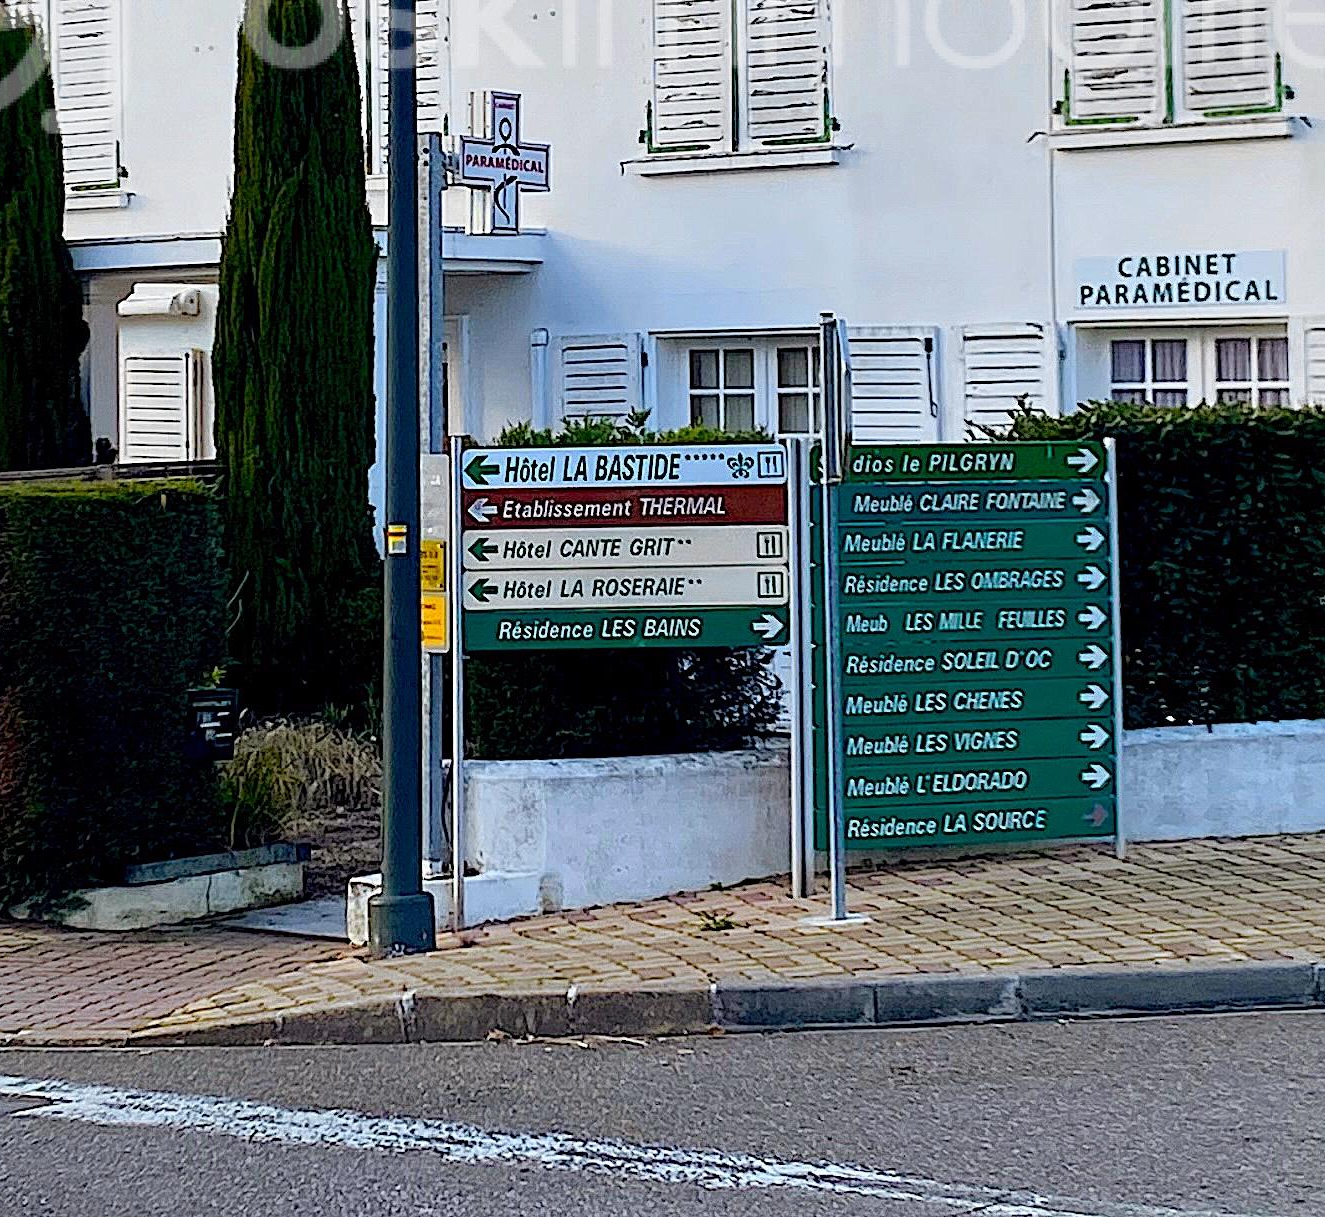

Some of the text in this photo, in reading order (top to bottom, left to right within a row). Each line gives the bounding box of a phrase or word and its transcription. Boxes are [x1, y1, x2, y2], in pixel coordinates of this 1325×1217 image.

[466, 154, 544, 174] PARAMÉDICAL
[1118, 253, 1237, 278] CABINET
[1080, 278, 1278, 305] PARAMÉDICAL
[504, 453, 681, 483] Hôtel LA BASTIDE
[902, 454, 921, 473] le
[928, 452, 1014, 473] PILGRYN
[502, 497, 726, 520] Etablissement THERMAL
[853, 491, 1066, 514] Meublé CLAIRE FONTAINE
[503, 537, 676, 560] Hôtel CANTE GRIT
[844, 531, 1024, 553] Meublé LA FLANERIE
[503, 577, 686, 599] Hôtel LA ROSERAIE
[844, 570, 1064, 594] Résidence LES OMBRAGES
[498, 617, 701, 641] Résidence LES BAINS
[846, 609, 1066, 633] Meub LES MILLE FEUILLES
[846, 654, 935, 674] Résidence
[941, 651, 999, 671] SOLEIL
[845, 690, 1023, 715] Meublé LES CHENES
[846, 731, 1018, 756] Meublé LES VIGNES
[847, 776, 910, 797] Meublé
[848, 809, 1048, 839] Résidence LA SOURCE
